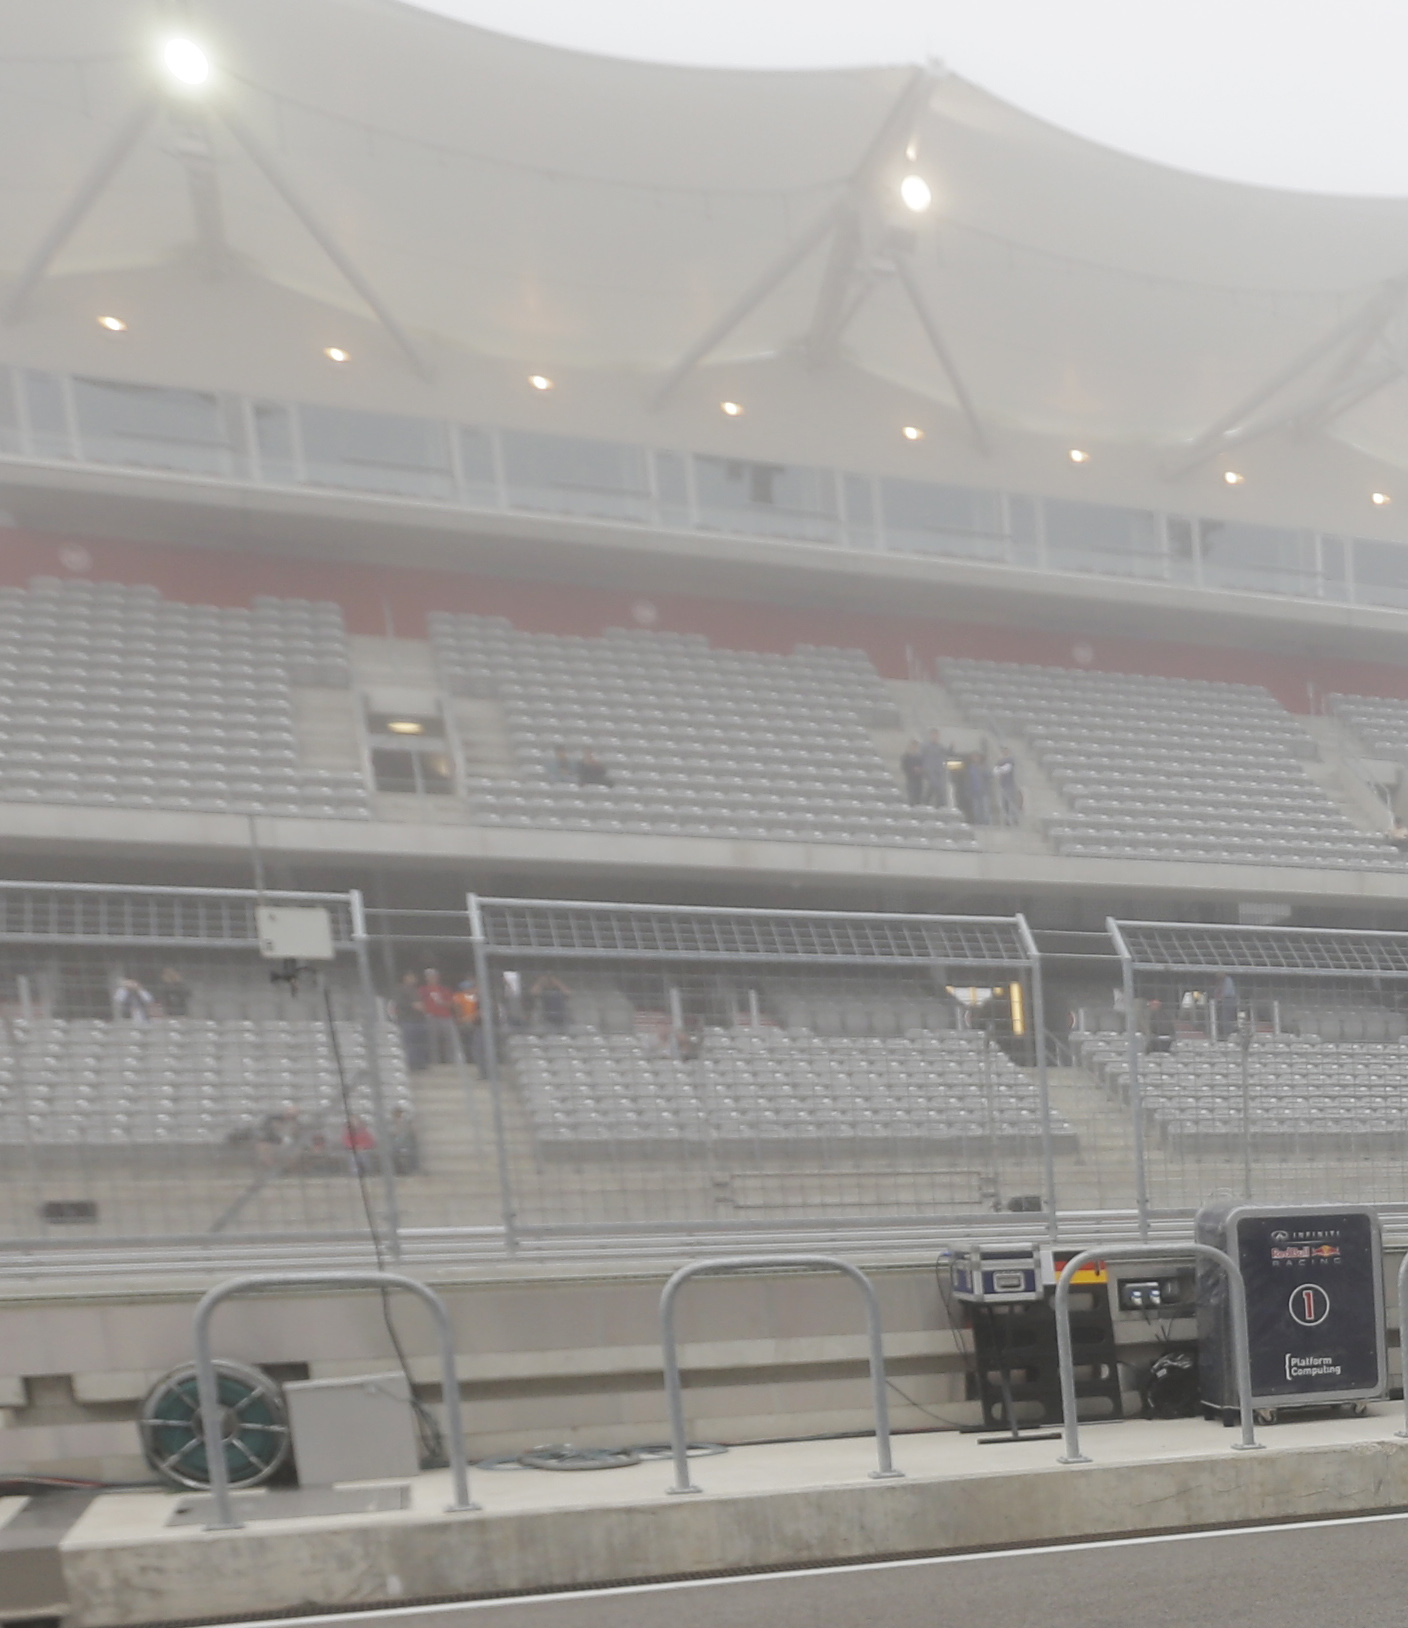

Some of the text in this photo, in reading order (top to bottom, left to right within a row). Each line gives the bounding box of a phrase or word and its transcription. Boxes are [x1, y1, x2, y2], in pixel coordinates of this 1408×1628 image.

[1272, 1257, 1342, 1266] RACING
[1290, 1357, 1333, 1367] Platform
[1290, 1364, 1342, 1377] Computing
